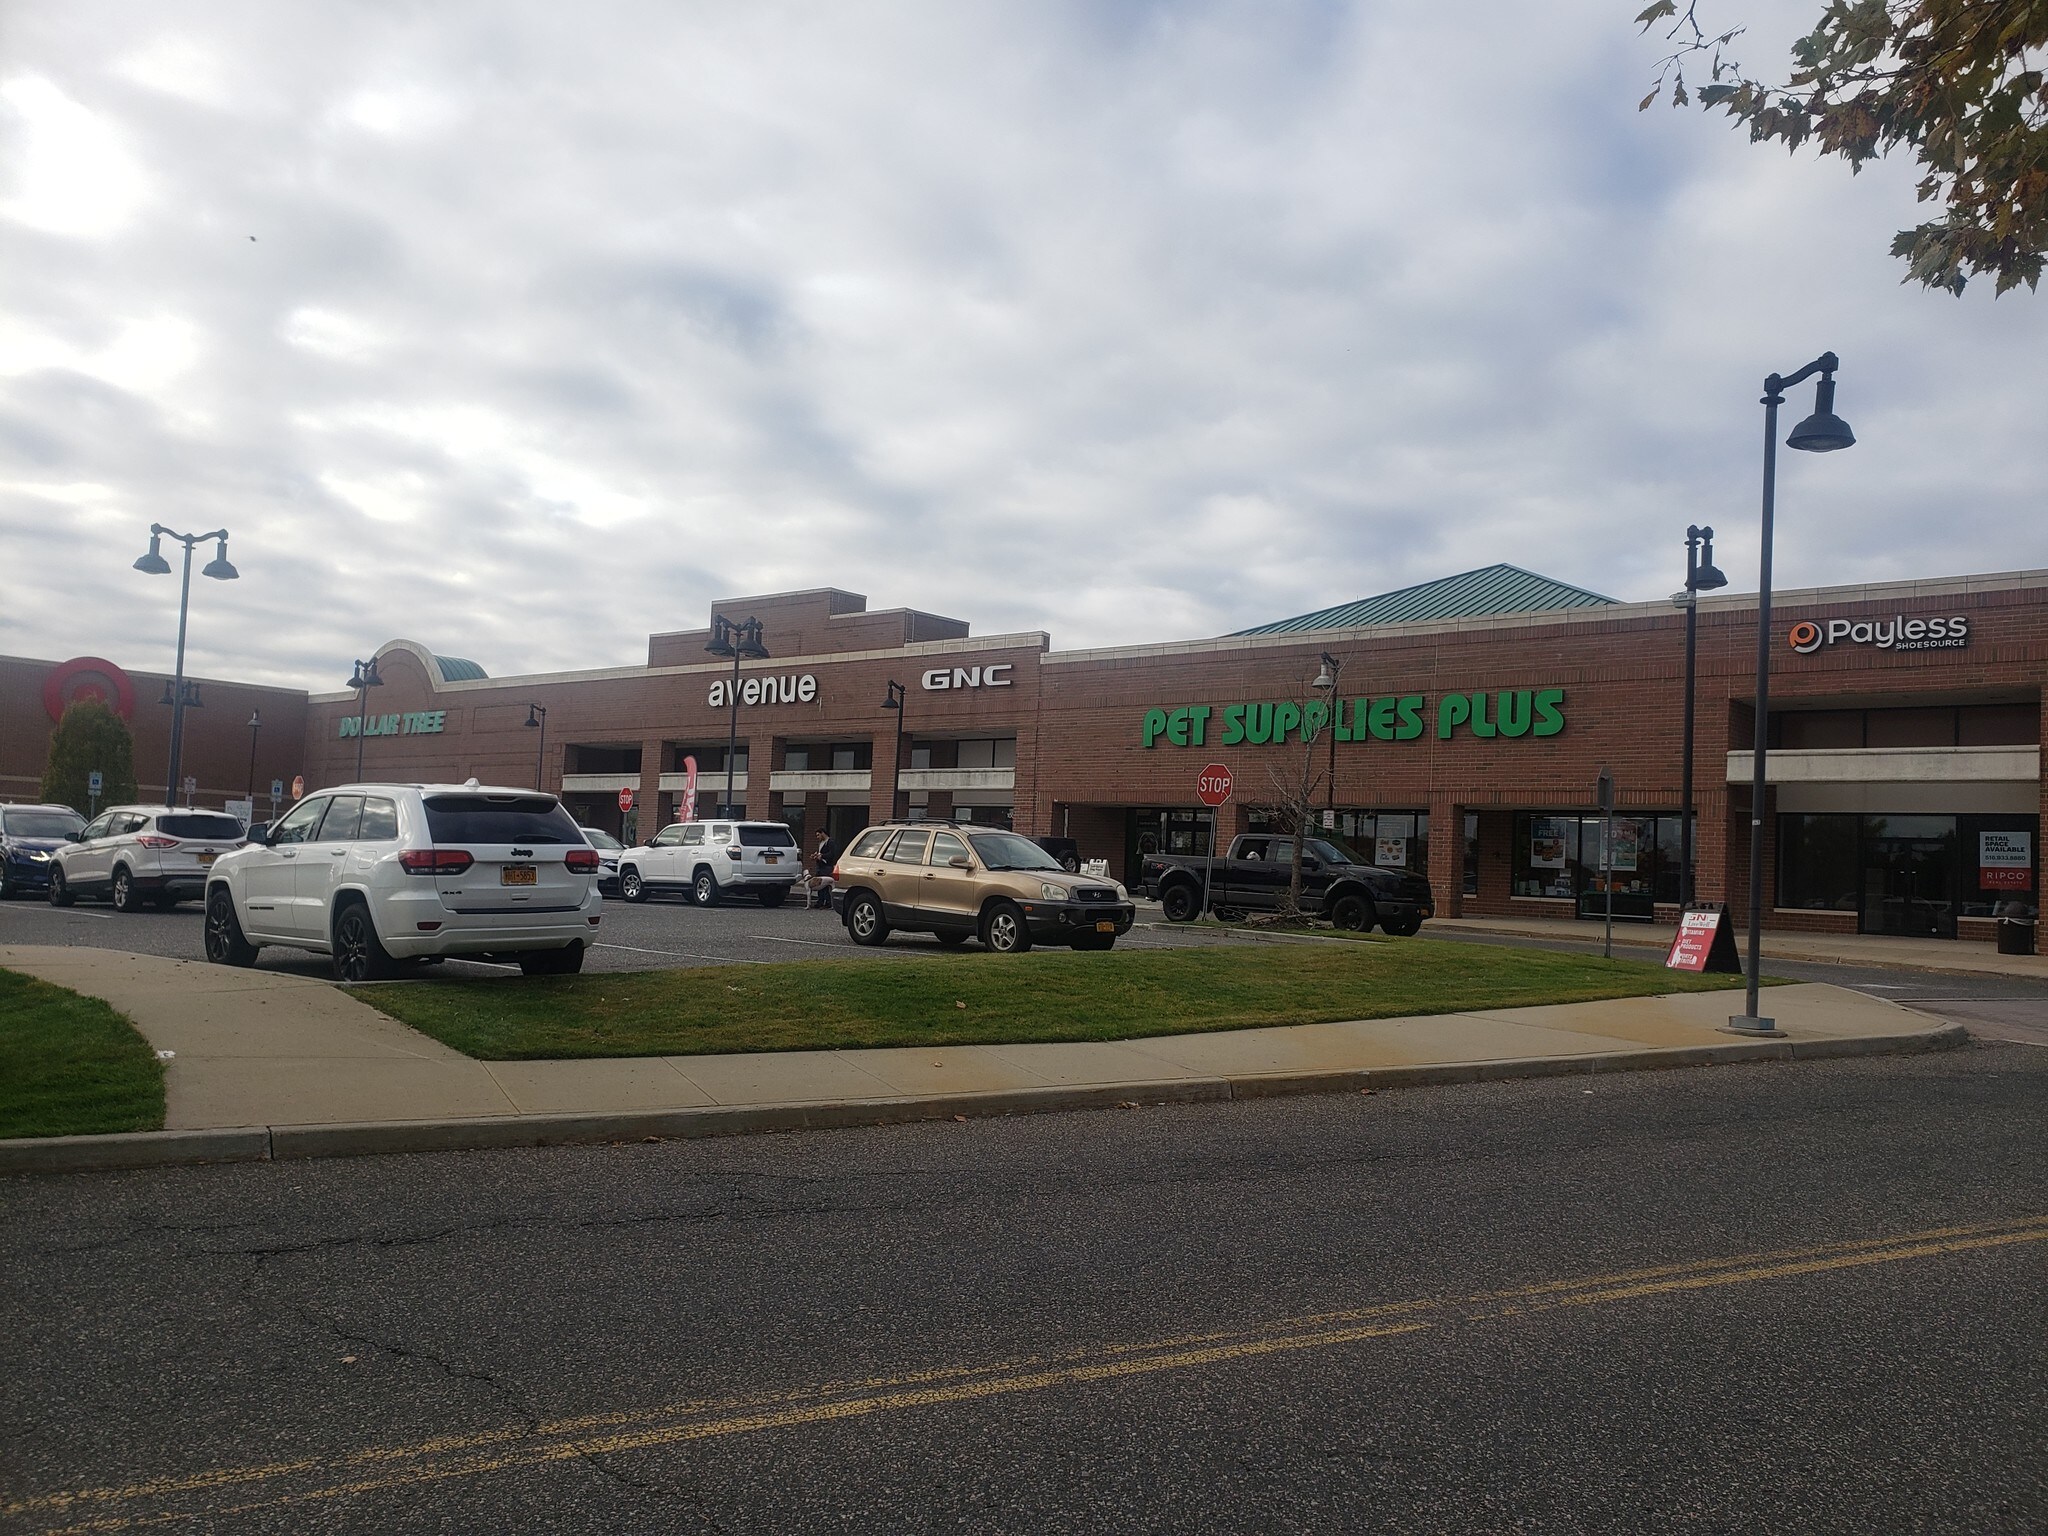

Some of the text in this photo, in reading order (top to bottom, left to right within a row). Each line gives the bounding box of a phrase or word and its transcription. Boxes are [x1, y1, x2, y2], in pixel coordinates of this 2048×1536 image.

[1828, 615, 1968, 648] Payless
[1896, 638, 1966, 650] SHOESOURCE
[921, 664, 1013, 690] GNC
[708, 674, 818, 707] avenue
[339, 711, 447, 737] DOLLAR TREE
[1143, 689, 1564, 747] PET SUPPLIES PLUS
[1200, 776, 1231, 794] STOP
[620, 794, 633, 804] STOP
[510, 847, 534, 858] Jeep
[1986, 872, 2025, 880] RIPCO
